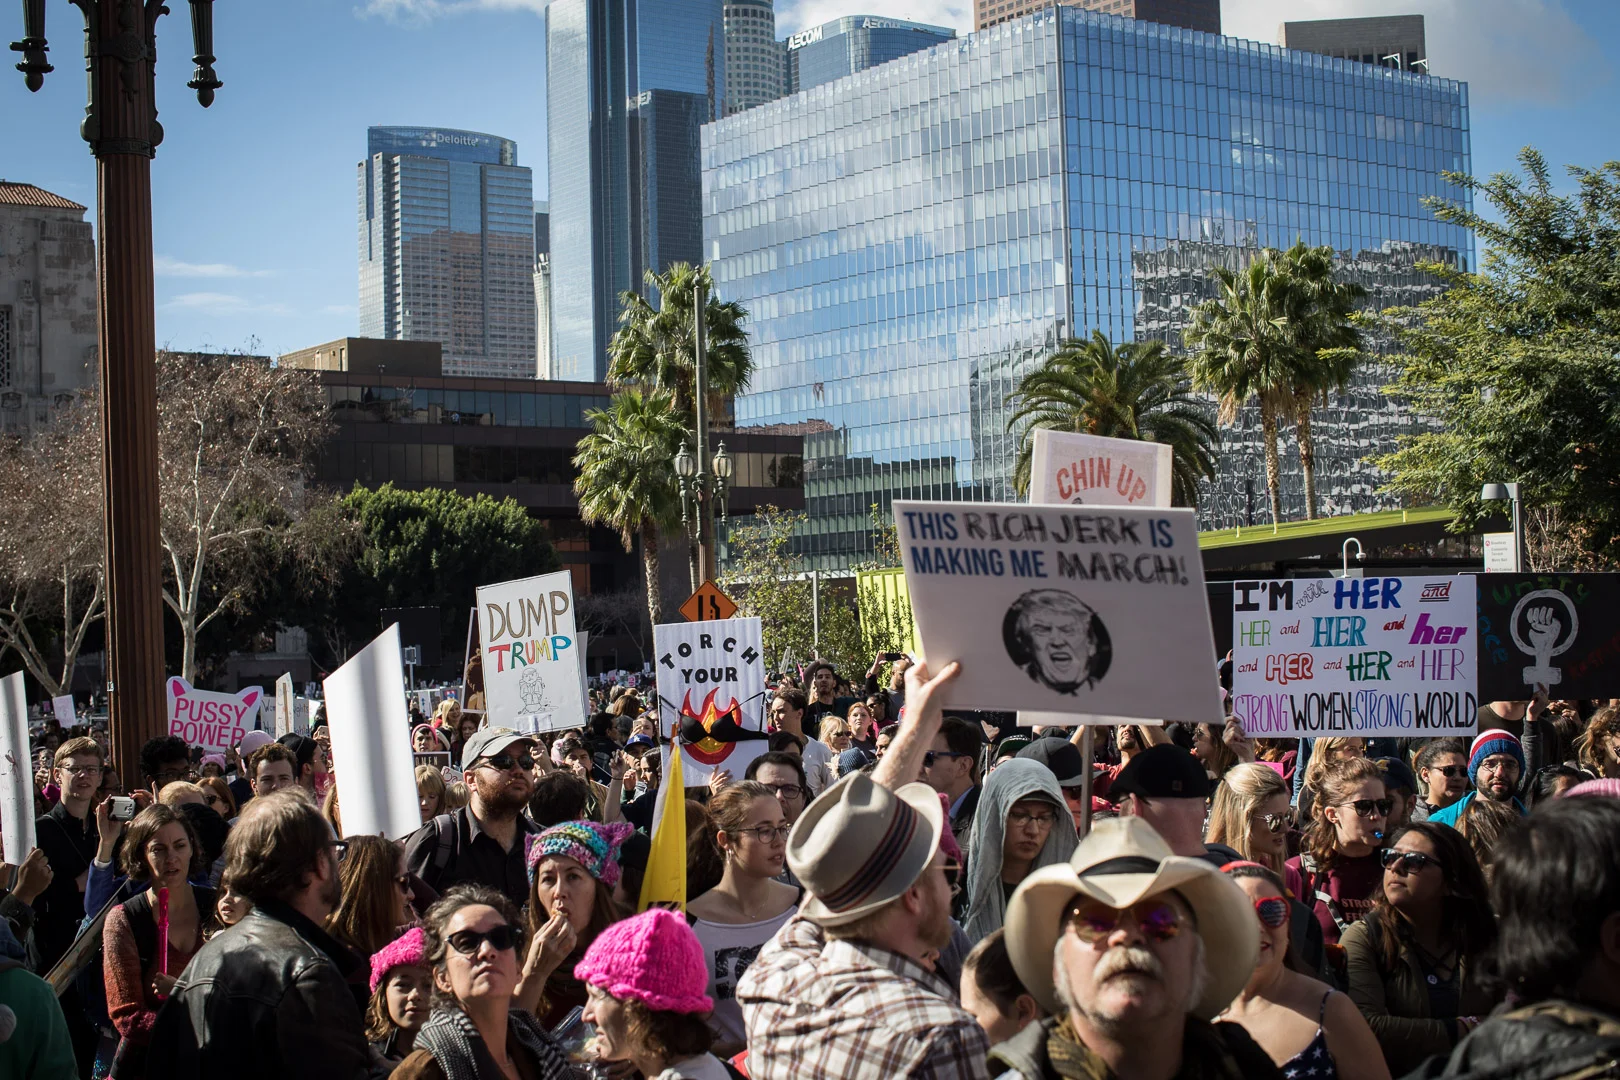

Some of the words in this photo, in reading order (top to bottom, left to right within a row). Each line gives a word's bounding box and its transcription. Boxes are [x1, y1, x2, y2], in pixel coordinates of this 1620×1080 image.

[787, 26, 823, 51] AECOM
[862, 17, 900, 29] AECOM
[437, 133, 476, 147] Deloitte
[1056, 457, 1111, 500] CHIN
[1116, 463, 1147, 503] UP
[903, 511, 958, 540] THIS
[963, 512, 1048, 543] RICH
[1051, 513, 1142, 545] JERK
[1149, 518, 1174, 548] IS
[910, 546, 1004, 576] MAKING
[1009, 549, 1048, 578] ME
[1057, 551, 1190, 586] MARCH!
[1235, 580, 1293, 611] I'M
[1296, 580, 1329, 609] with
[1334, 578, 1402, 610] HER
[1421, 581, 1452, 598] and
[486, 591, 569, 642] DUMP
[1240, 620, 1271, 647] HER
[1280, 620, 1300, 635] and
[1310, 615, 1368, 648] HER
[1383, 614, 1407, 631] and
[1408, 613, 1468, 645] her
[488, 635, 572, 673] TRUMP
[660, 633, 759, 670] TORCH
[1238, 658, 1258, 673] and
[1265, 652, 1314, 685] HER
[1323, 657, 1342, 671] and
[1346, 650, 1392, 682] HER
[1397, 656, 1415, 669] and
[1421, 648, 1466, 681] HER
[681, 666, 738, 684] YOUR
[174, 698, 248, 727] PUSSY
[1235, 693, 1288, 733] STRONG
[1290, 692, 1353, 731] WOMEN
[1355, 689, 1412, 730] STRONG
[1414, 691, 1477, 729] WORLD
[169, 719, 246, 748] POWER
[415, 756, 438, 766] OMEN
